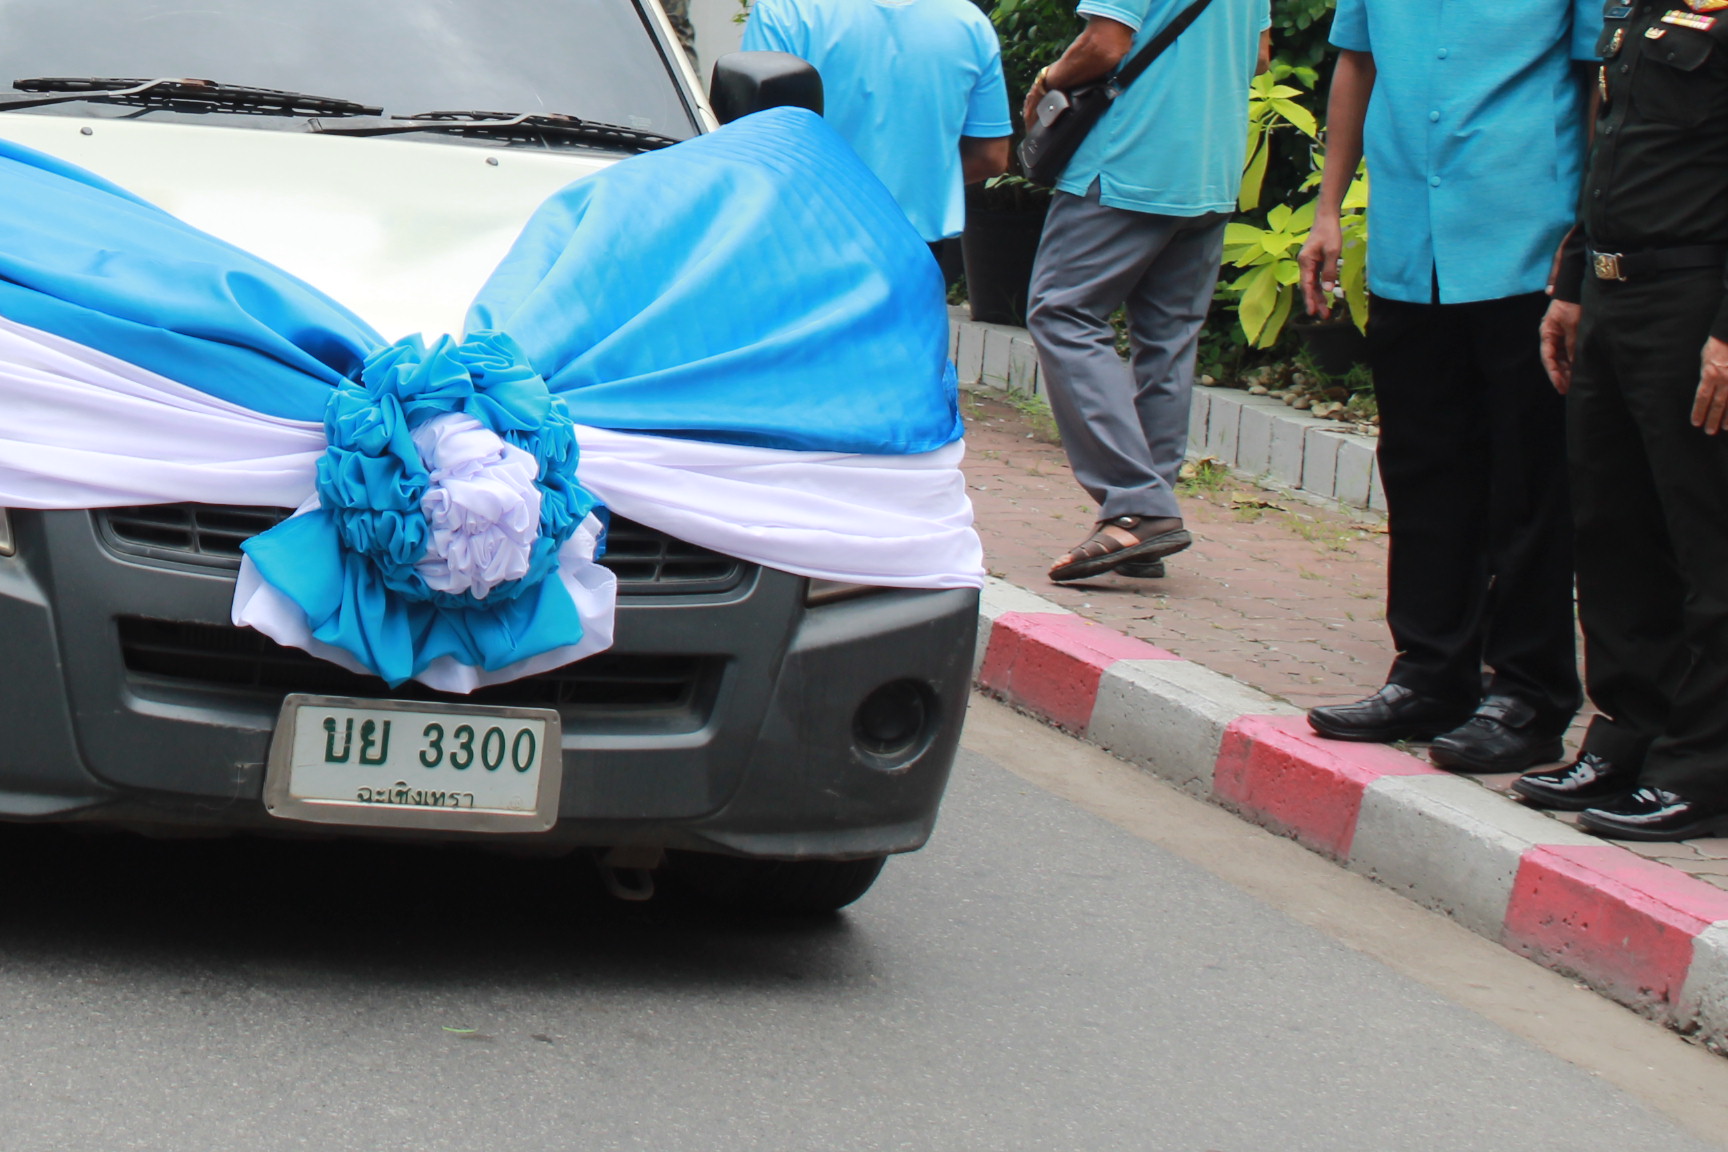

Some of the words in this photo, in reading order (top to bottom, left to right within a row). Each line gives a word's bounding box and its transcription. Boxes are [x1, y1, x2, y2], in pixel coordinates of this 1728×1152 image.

[323, 716, 391, 766] บย
[419, 722, 536, 773] 3300
[357, 780, 474, 809] ฉะเชิงเทรา
